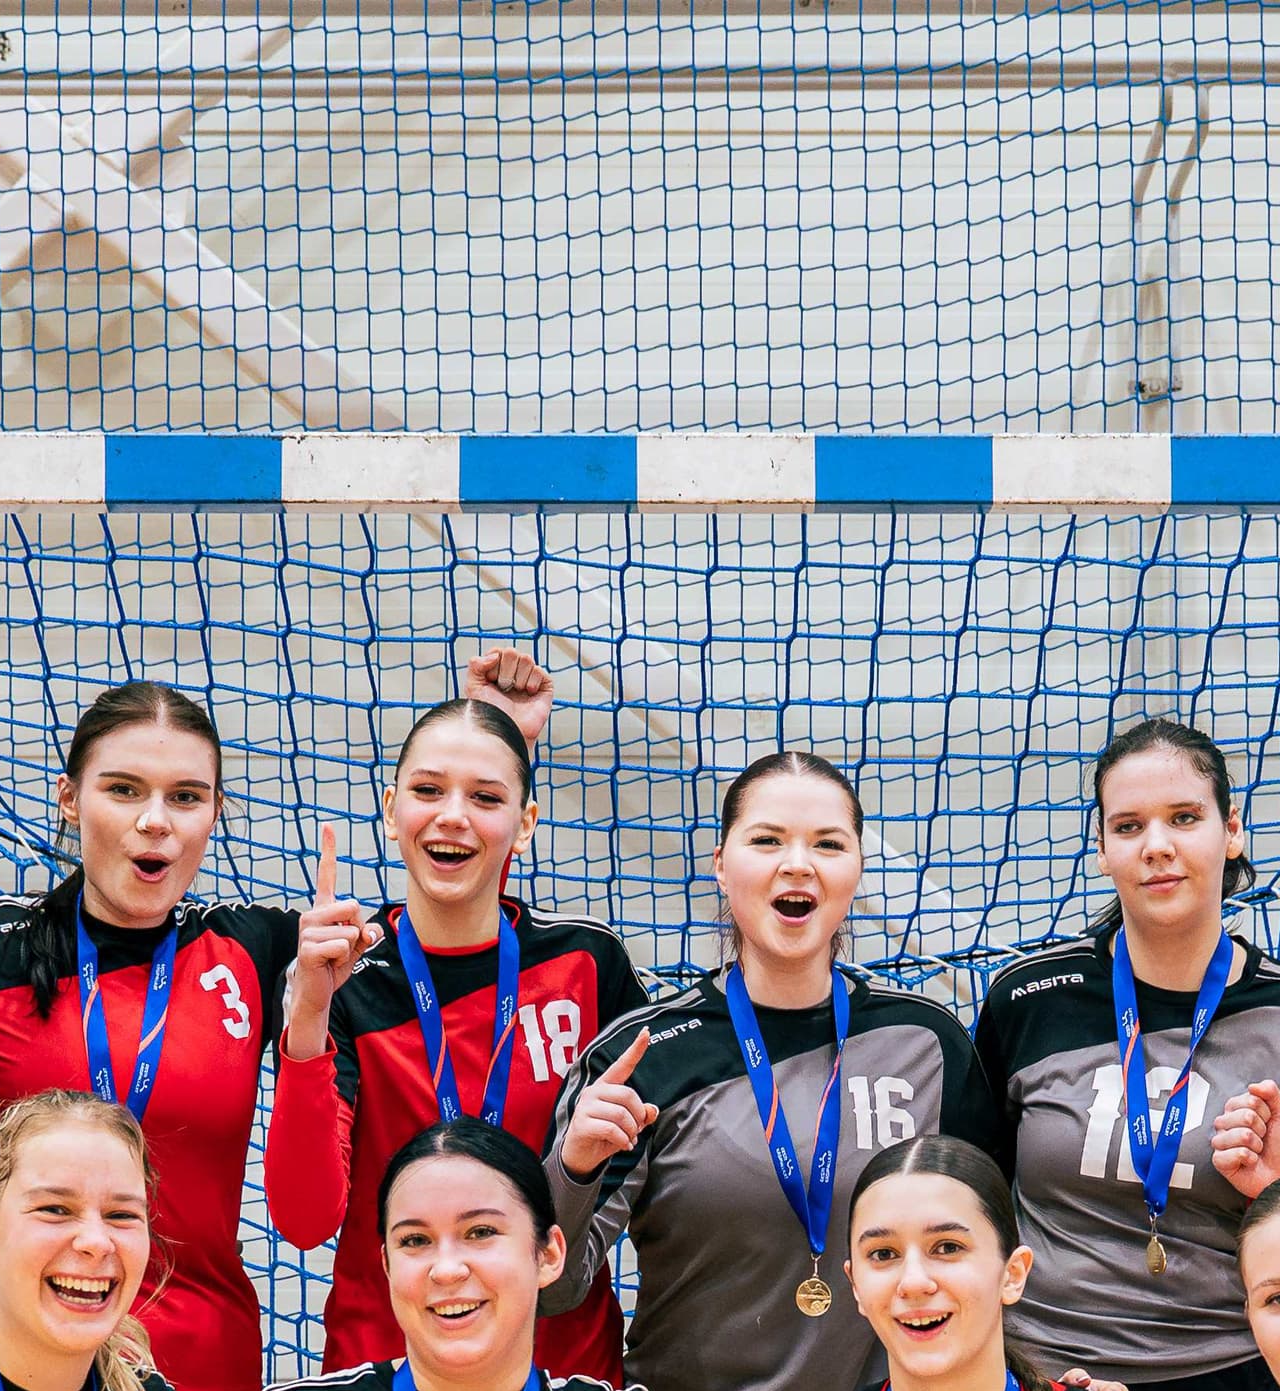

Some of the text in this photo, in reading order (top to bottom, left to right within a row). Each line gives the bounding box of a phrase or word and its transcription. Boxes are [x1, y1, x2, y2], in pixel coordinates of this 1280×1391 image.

[199, 963, 251, 1040] 3
[517, 999, 581, 1082] 18
[847, 1076, 916, 1150] 16
[1080, 1064, 1210, 1190] 12
